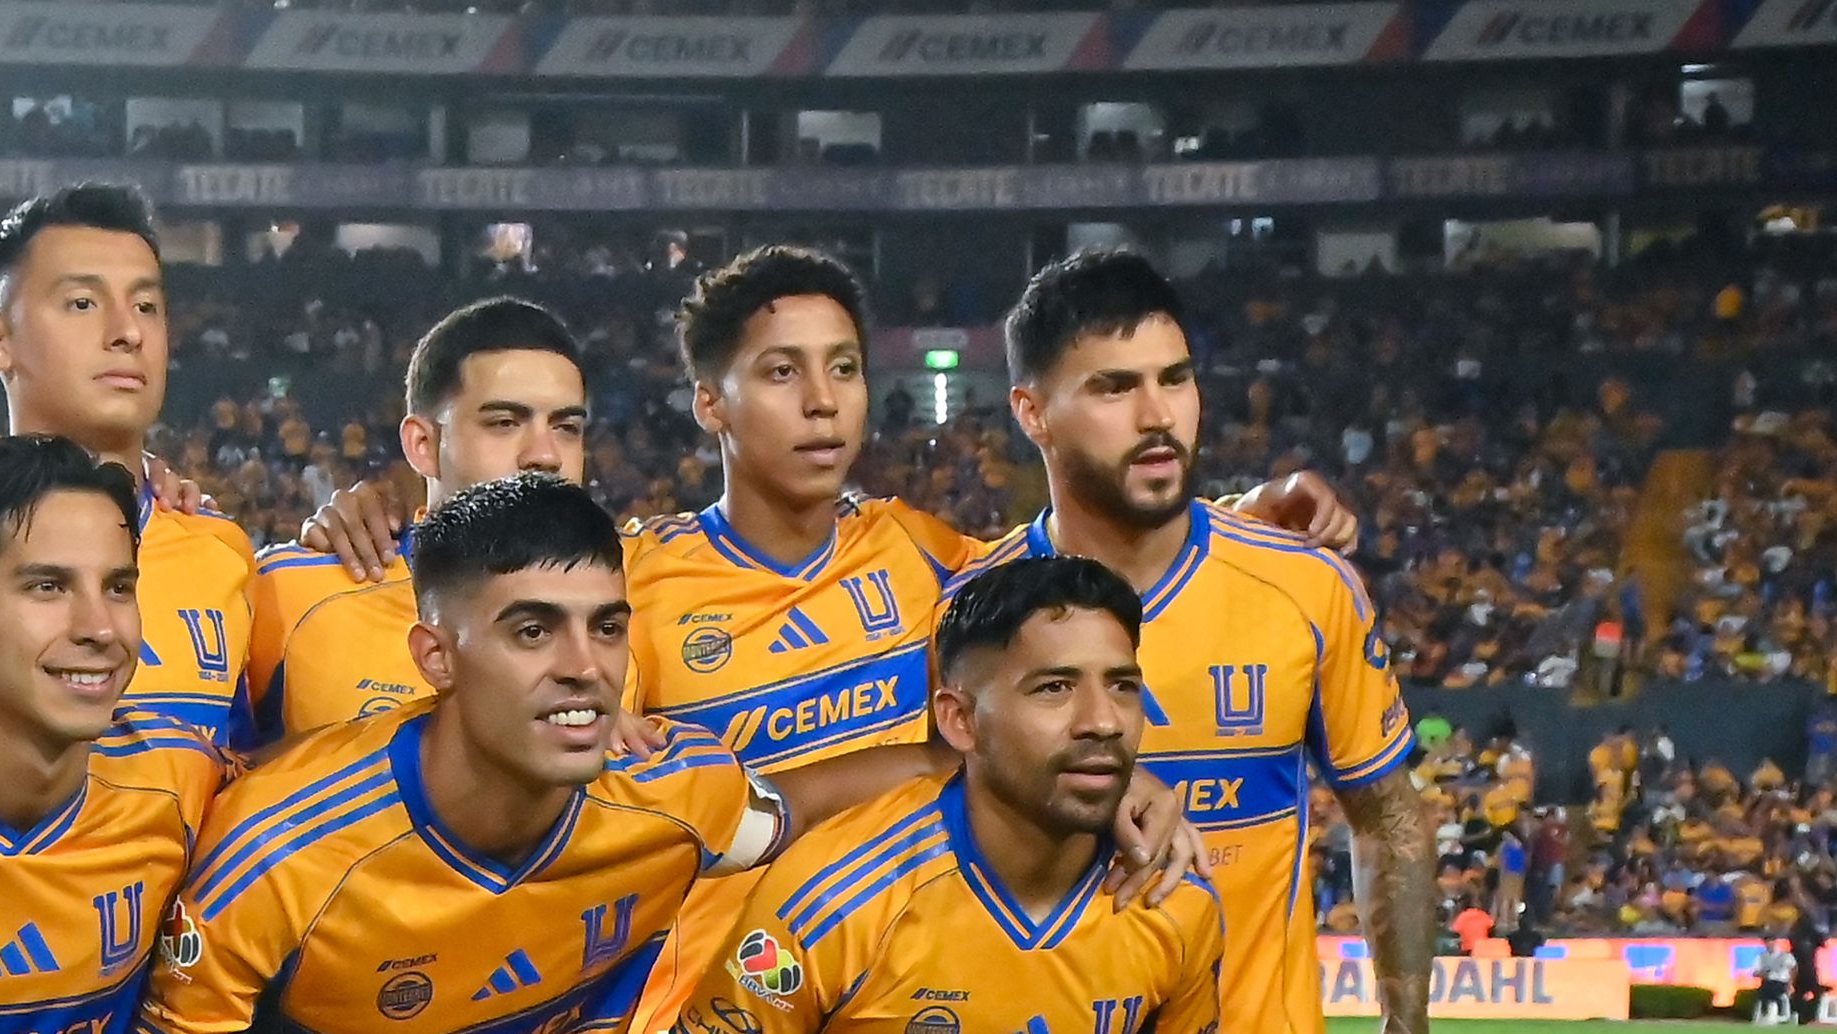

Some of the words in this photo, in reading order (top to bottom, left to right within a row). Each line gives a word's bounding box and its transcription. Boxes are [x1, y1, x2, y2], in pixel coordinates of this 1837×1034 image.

[1217, 22, 1347, 54] CEMEX
[1518, 13, 1653, 44] CEMEX
[627, 35, 751, 63] CEMEX
[919, 35, 1047, 62] CEMEX
[1144, 161, 1259, 201] TECATE
[839, 569, 901, 633] U
[177, 609, 228, 672] U
[370, 682, 418, 696] CEMEX
[1207, 663, 1268, 727] U
[766, 675, 900, 743] CEMEX
[93, 881, 145, 967] U
[580, 892, 640, 970] U
[392, 952, 439, 969] CEMEX
[925, 989, 971, 1002] CEMEX
